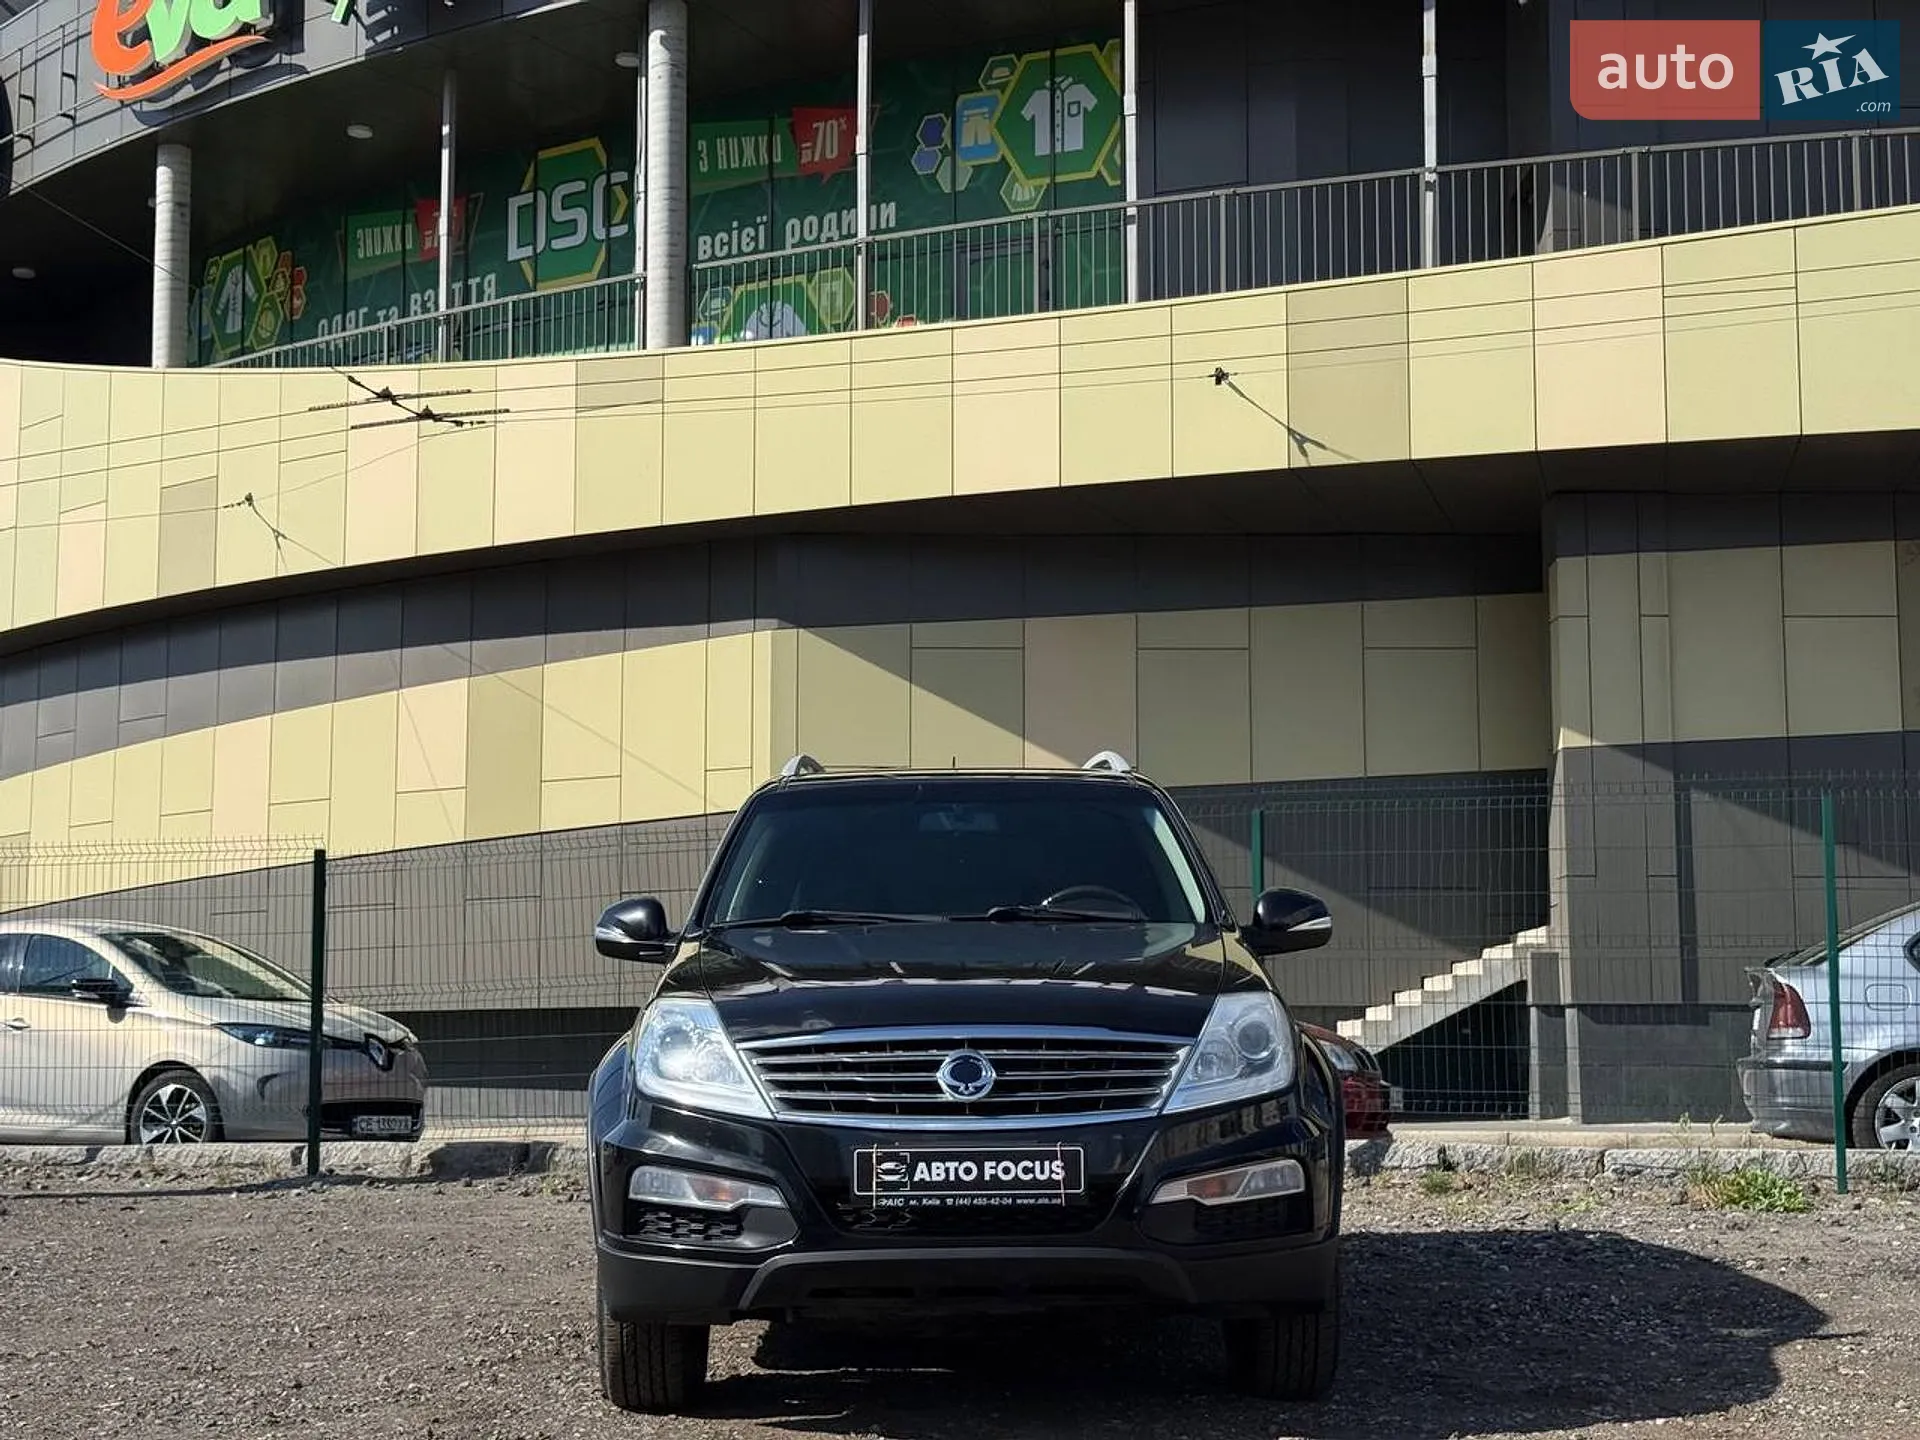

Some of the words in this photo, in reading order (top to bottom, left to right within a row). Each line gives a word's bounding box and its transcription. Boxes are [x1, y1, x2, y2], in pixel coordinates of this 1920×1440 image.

[507, 170, 629, 262] DSC
[697, 215, 768, 261] всієї
[983, 1159, 1065, 1182] FOCUS
